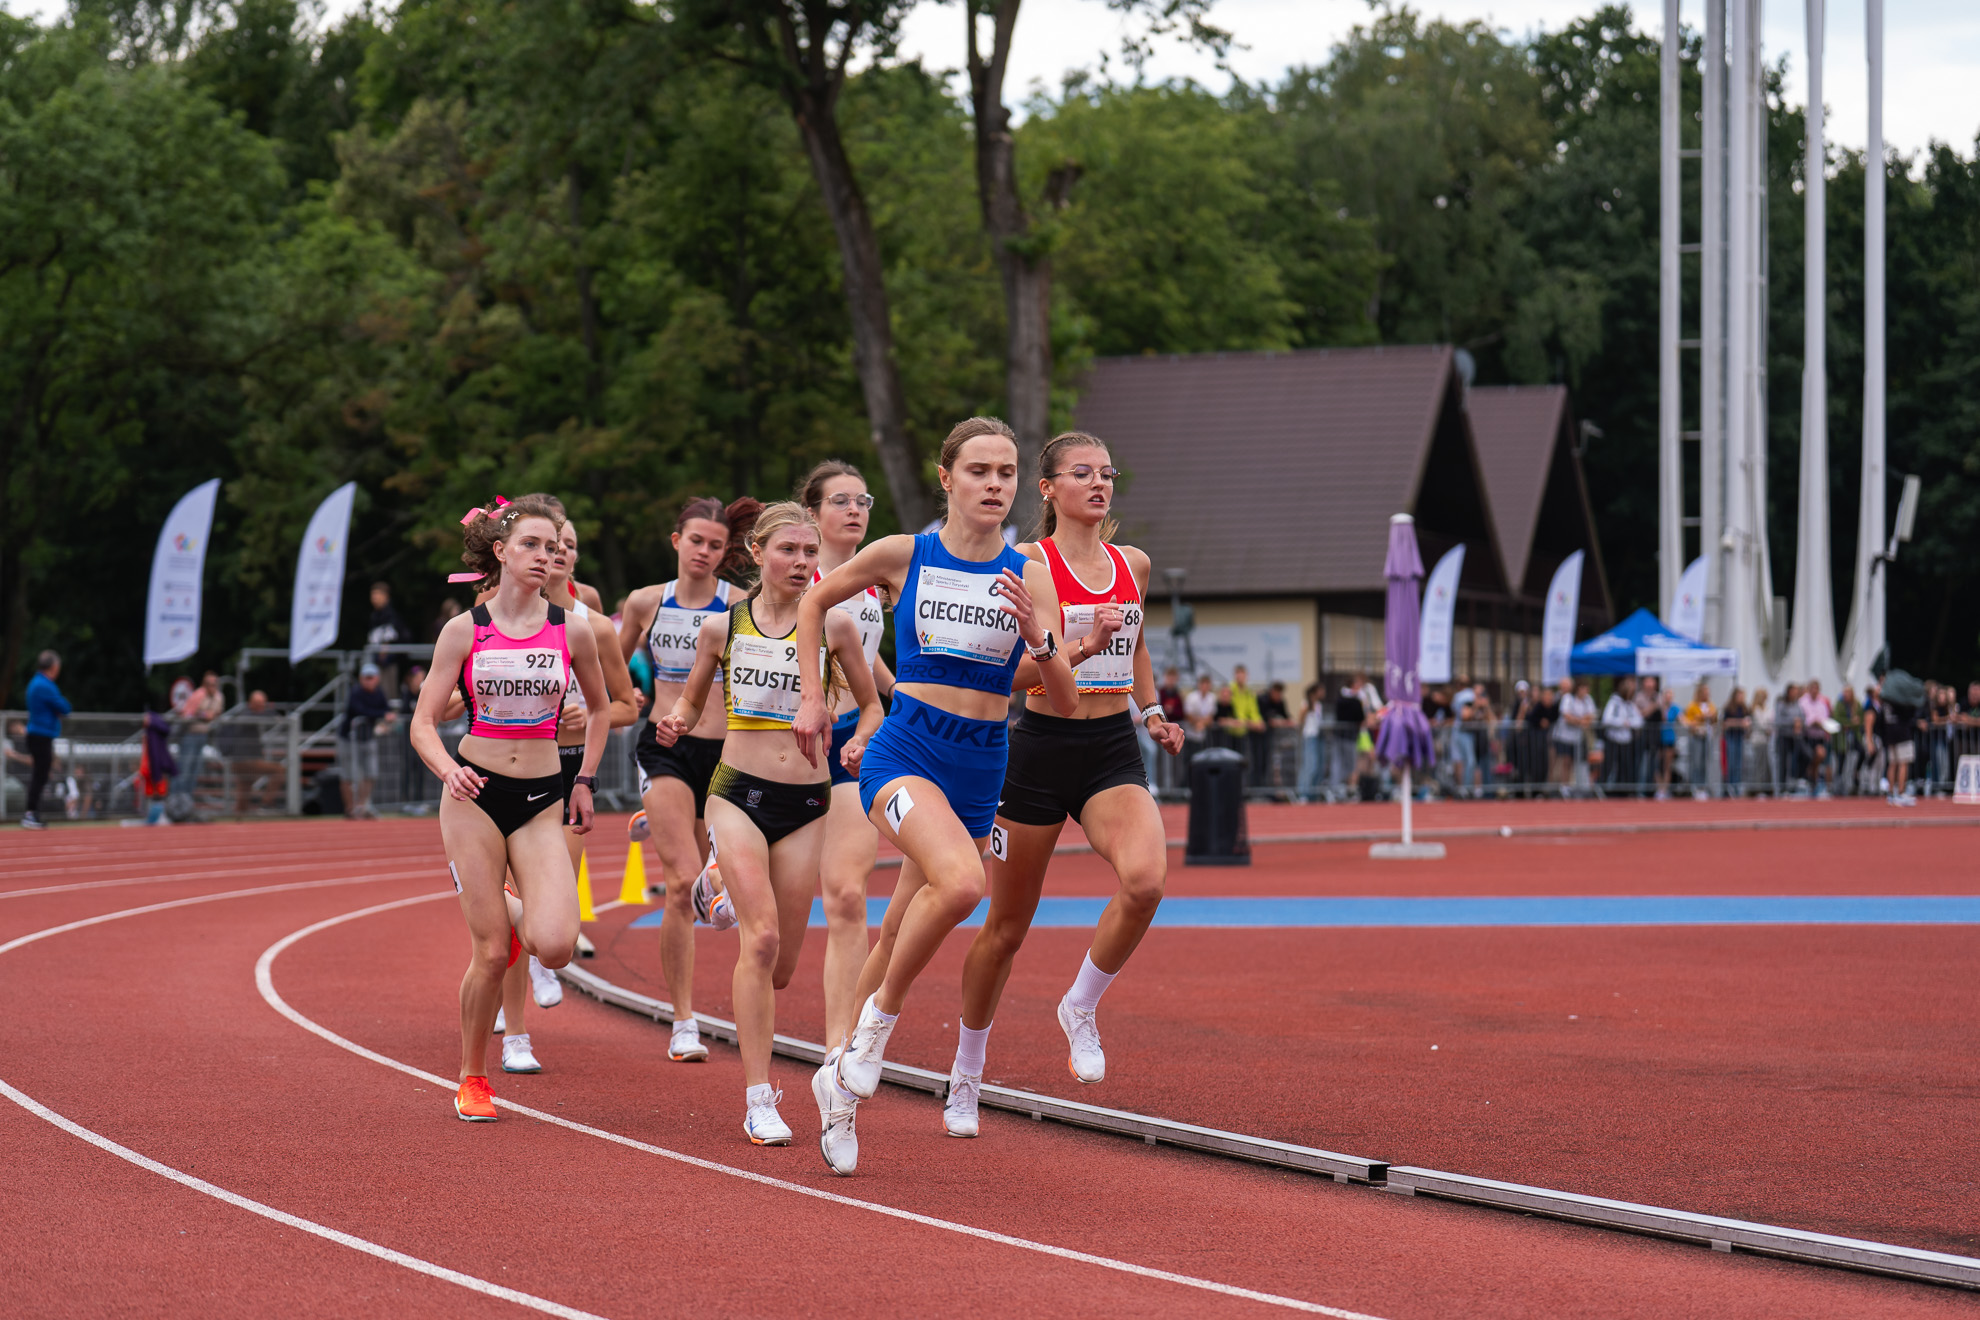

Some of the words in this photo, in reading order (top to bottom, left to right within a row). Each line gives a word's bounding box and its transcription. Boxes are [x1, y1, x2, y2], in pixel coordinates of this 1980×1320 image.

[693, 615, 708, 627] 8
[860, 607, 880, 623] 660
[919, 599, 1017, 634] CIECIERSKA
[1096, 637, 1134, 656] REK
[526, 653, 556, 669] 927
[476, 679, 560, 697] SZYDERSKA
[733, 666, 801, 693] SZUSTE
[900, 664, 947, 679] PRO
[959, 669, 1009, 690] NIKE
[907, 705, 1008, 748] NIKE
[886, 792, 902, 823] 7
[992, 826, 1003, 856] 6
